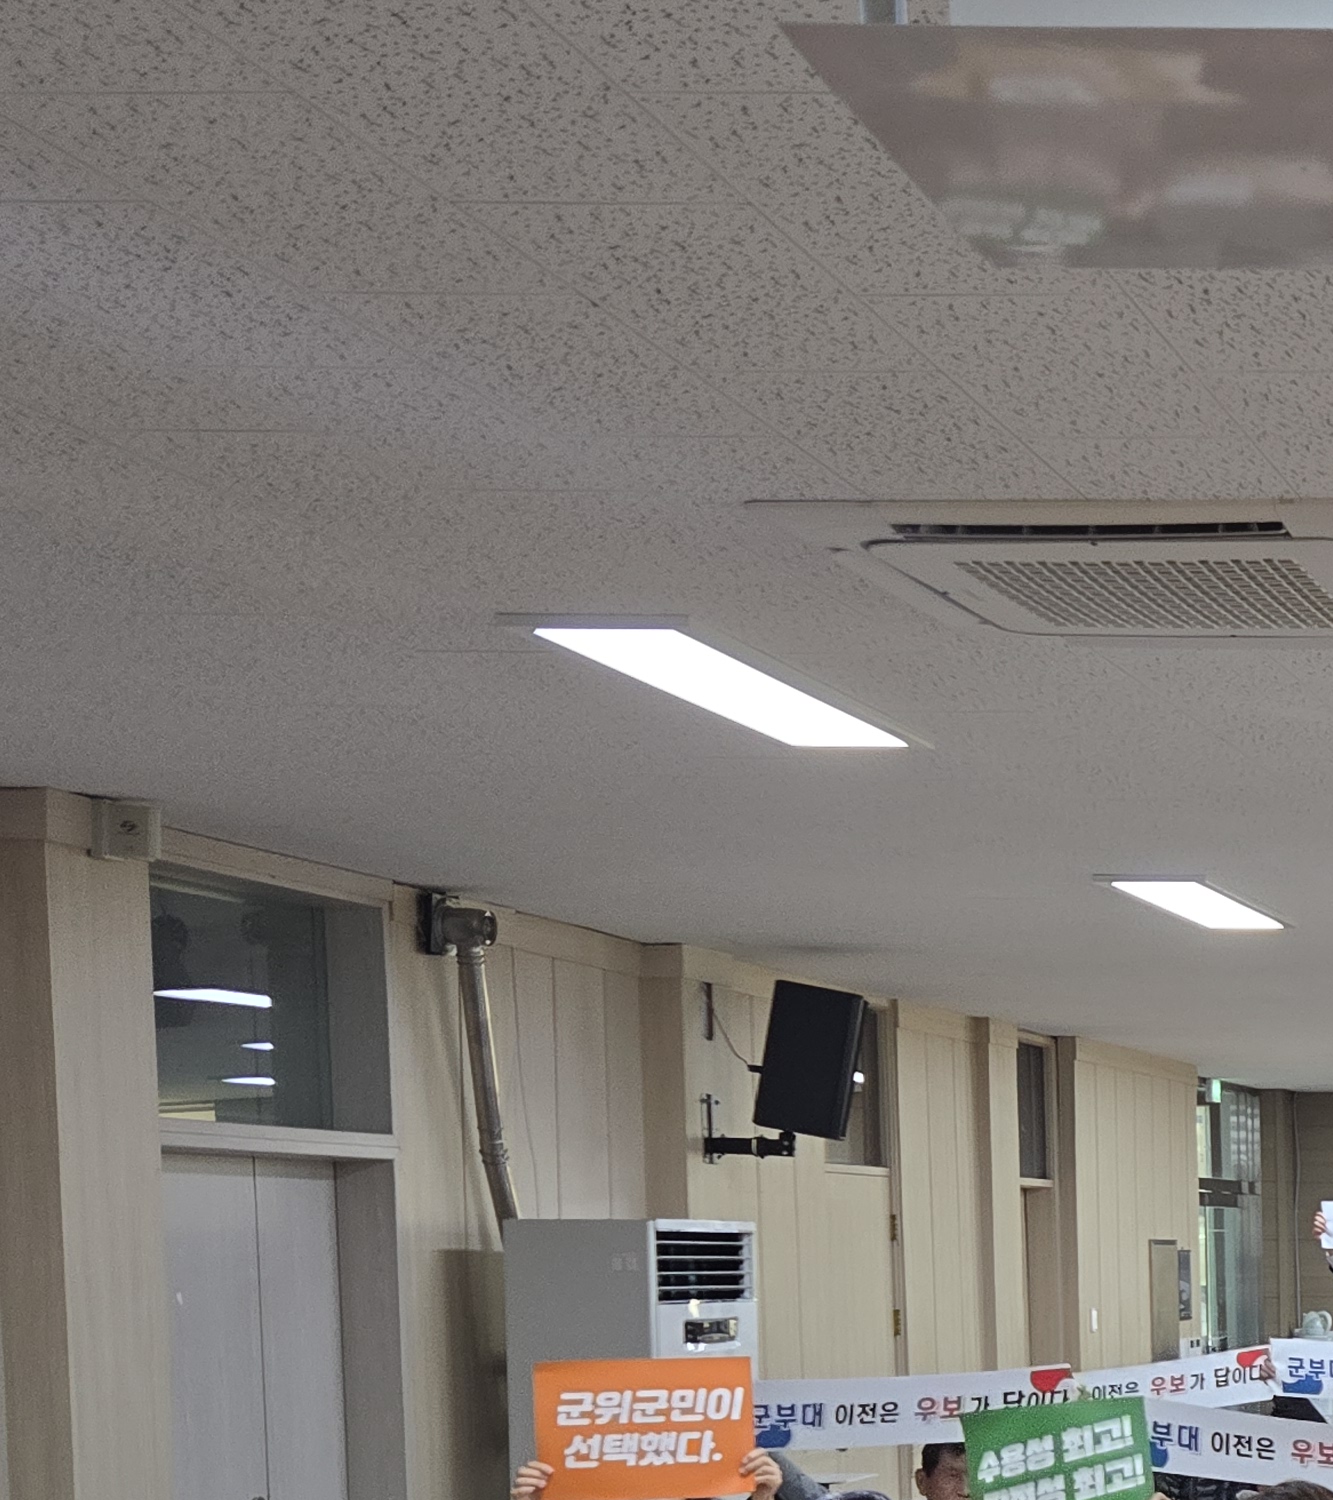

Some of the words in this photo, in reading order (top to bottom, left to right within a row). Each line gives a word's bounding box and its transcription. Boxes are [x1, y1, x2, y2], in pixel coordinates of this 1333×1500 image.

[556, 1387, 744, 1426] 군위군민이
[835, 1401, 899, 1426] 이전은
[564, 1430, 723, 1469] 선택했다.
[1151, 1420, 1199, 1452] 부대
[1210, 1431, 1276, 1460] 이전은
